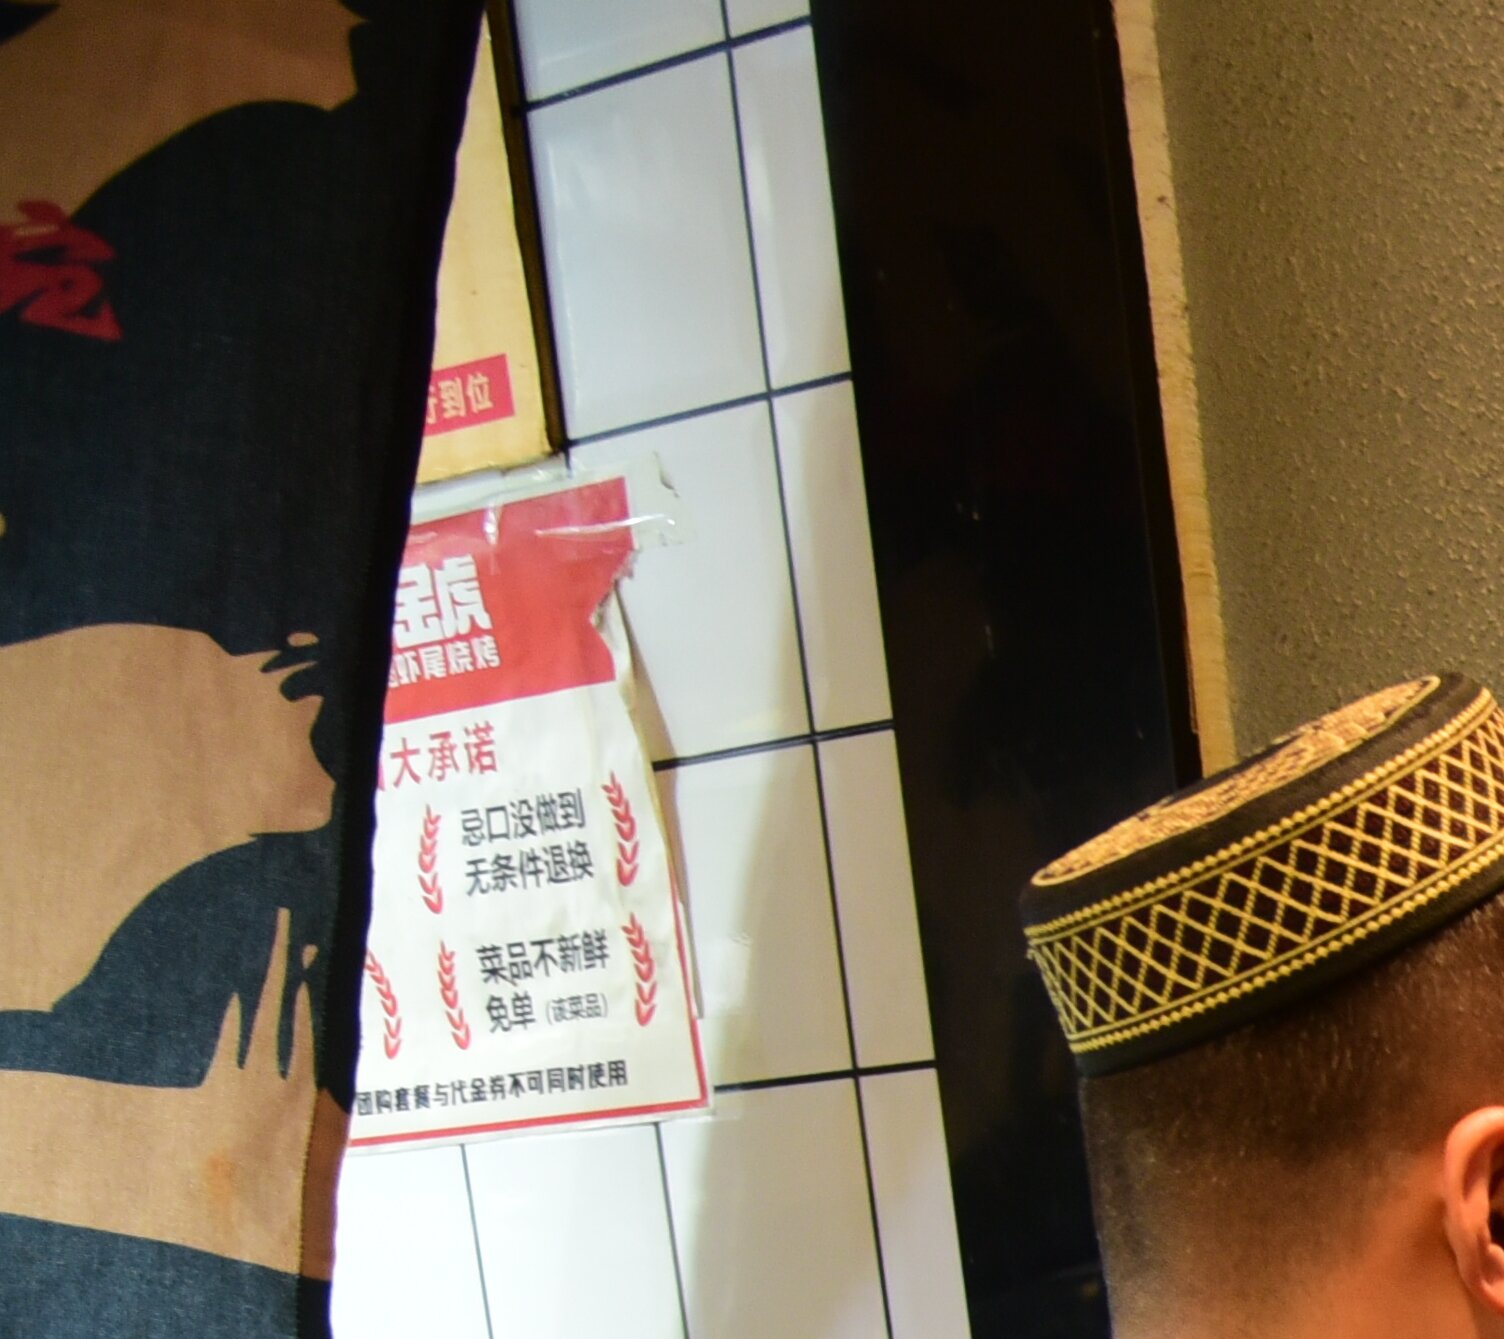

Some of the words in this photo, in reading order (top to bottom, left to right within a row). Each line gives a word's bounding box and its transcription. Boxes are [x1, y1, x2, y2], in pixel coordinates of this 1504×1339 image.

[377, 720, 499, 793] 大承诺
[465, 840, 595, 897] 无条件退换
[476, 928, 611, 987] 菜品不新鲜
[486, 991, 536, 1034] 免单
